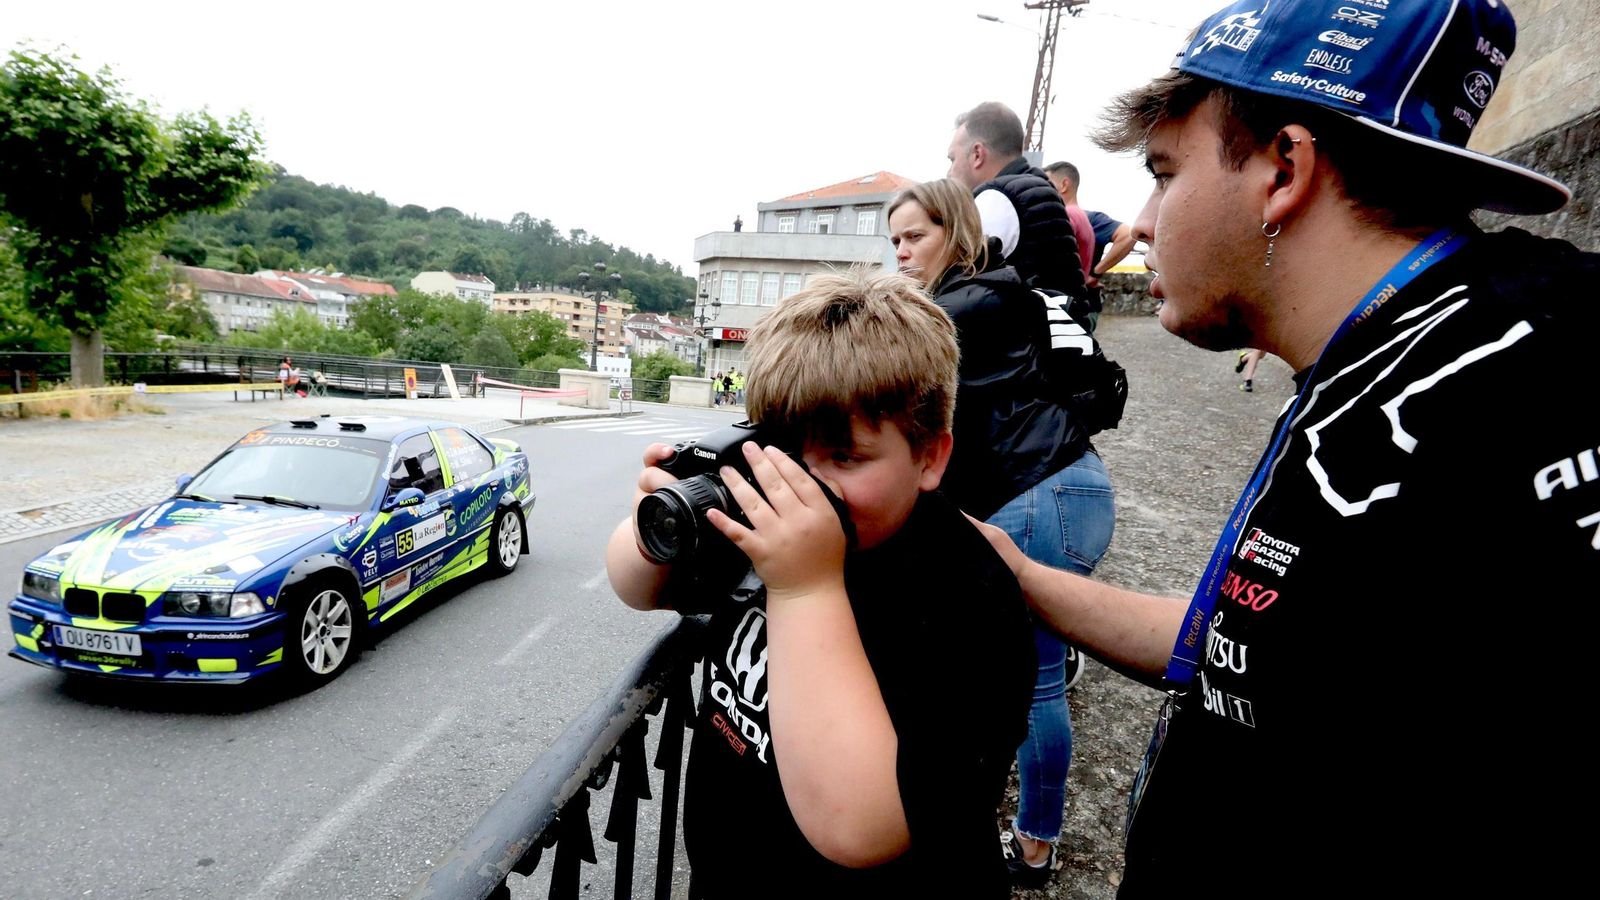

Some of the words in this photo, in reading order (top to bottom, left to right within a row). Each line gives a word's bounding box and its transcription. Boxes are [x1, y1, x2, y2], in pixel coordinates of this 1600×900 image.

[1318, 30, 1371, 47] Eibach
[1306, 49, 1353, 72] ENDLESS
[694, 448, 717, 460] Canon
[1534, 446, 1600, 500] AI
[400, 497, 419, 506] MATEO
[460, 488, 492, 525] COPILOTO
[1232, 486, 1256, 531] Recalvi
[398, 531, 413, 554] 55
[414, 532, 423, 541] La
[1251, 541, 1292, 565] GAZOO
[1257, 531, 1300, 556] TOYOTA
[1246, 551, 1287, 577] Racing
[1183, 608, 1205, 649] Recalvi
[66, 630, 83, 646] OU
[86, 632, 121, 651] 8761
[125, 636, 134, 652] V
